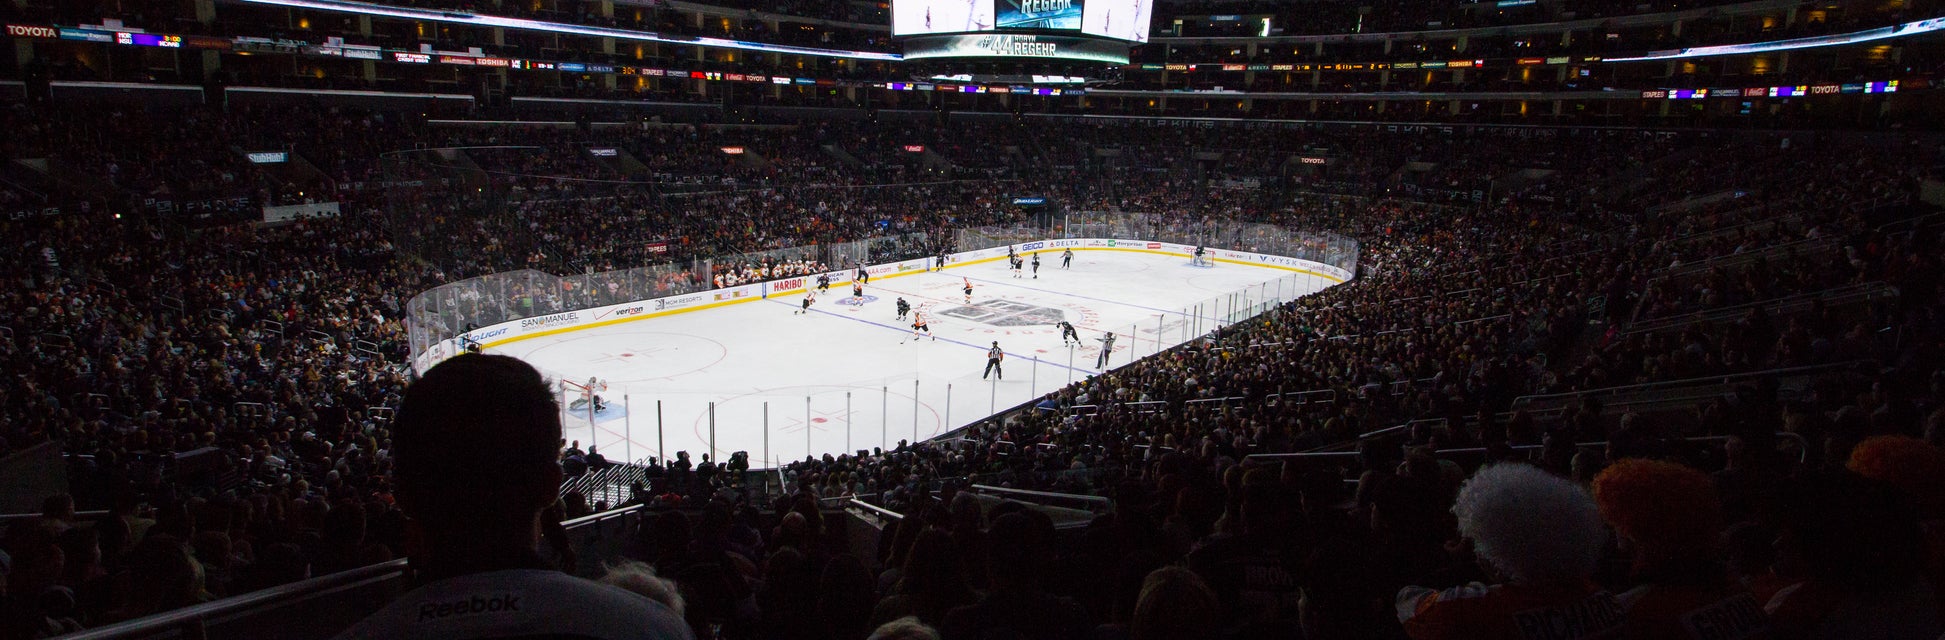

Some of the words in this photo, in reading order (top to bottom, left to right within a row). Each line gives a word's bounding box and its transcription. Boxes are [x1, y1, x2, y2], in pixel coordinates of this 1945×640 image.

[1021, 0, 1071, 14] REGEHR
[7, 25, 57, 38] TOYOTA
[1014, 42, 1056, 56] REGEHR
[1022, 242, 1044, 251] GEICO
[774, 278, 802, 292] HARIBO
[616, 306, 644, 315] verizon
[522, 318, 538, 327] SAN
[546, 313, 579, 323] MANUEL
[480, 328, 508, 340] LIGHT
[418, 594, 521, 622] Reebok
